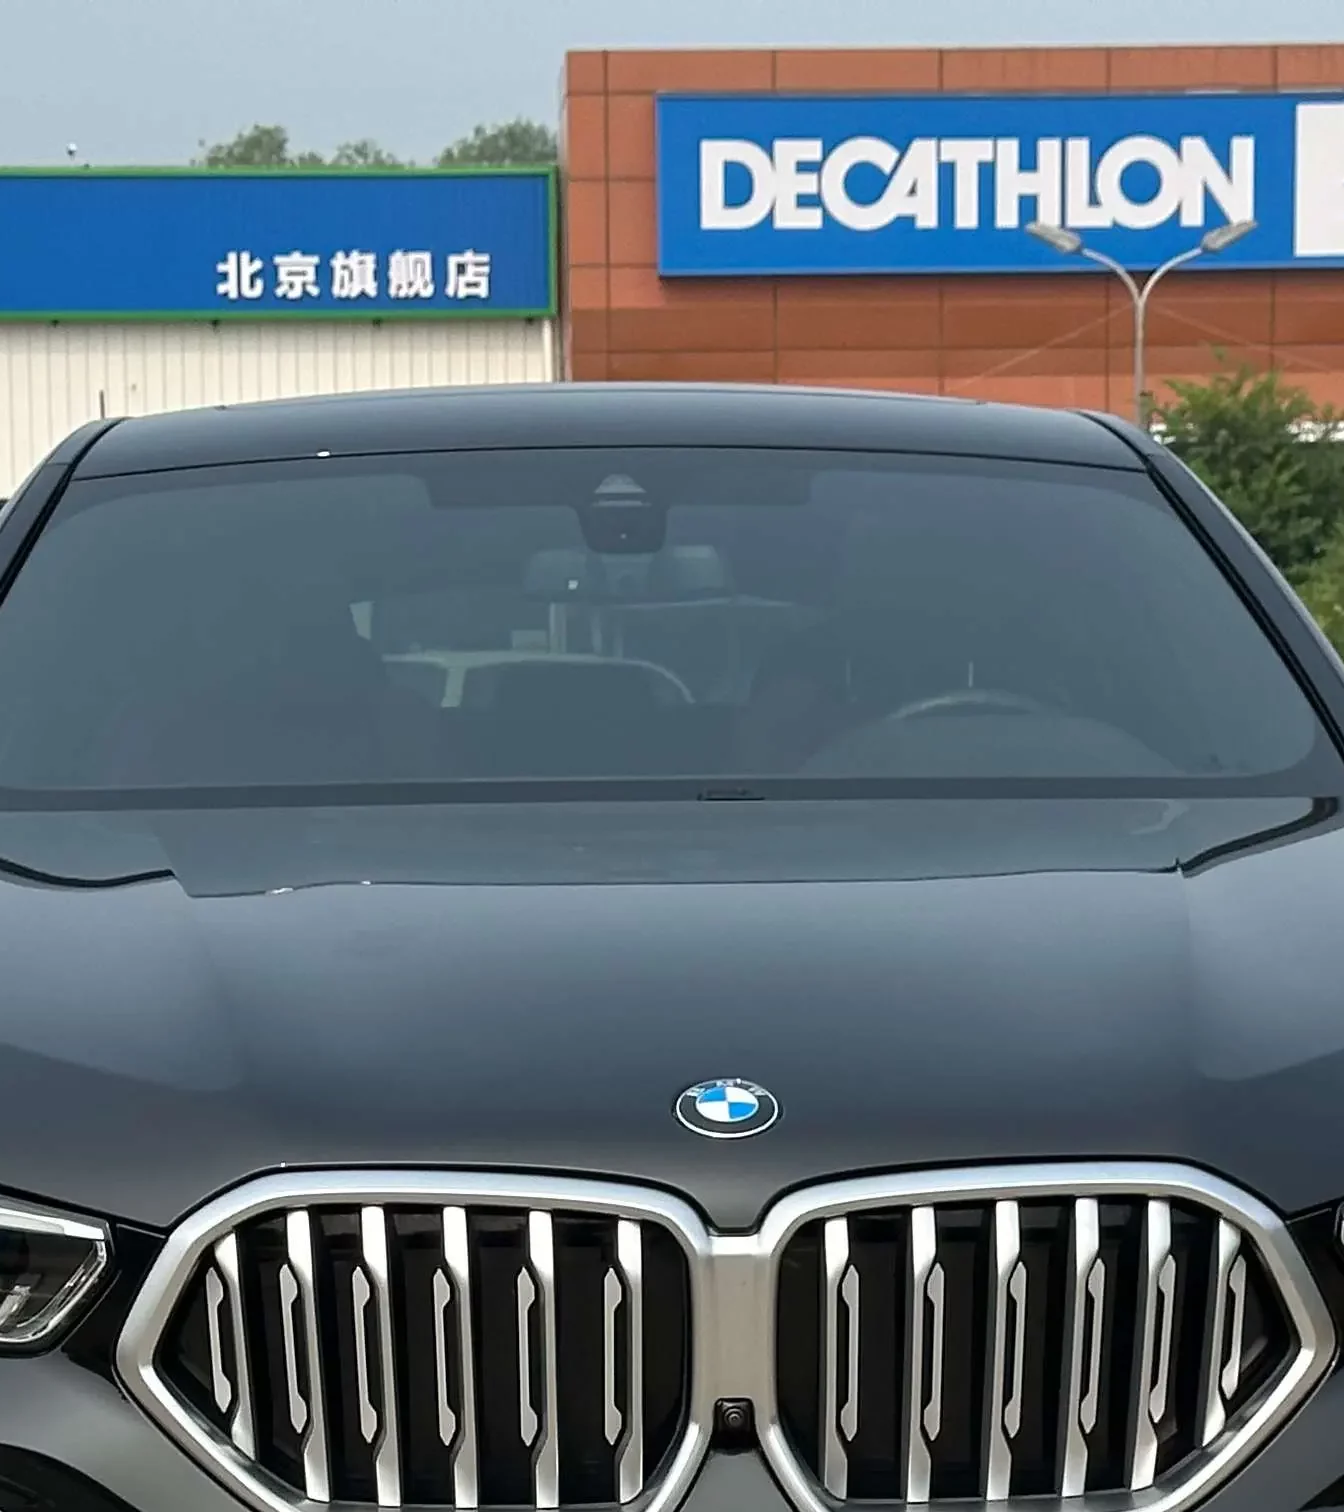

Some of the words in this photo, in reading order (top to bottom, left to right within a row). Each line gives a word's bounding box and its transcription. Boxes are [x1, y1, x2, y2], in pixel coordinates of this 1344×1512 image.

[699, 135, 1256, 231] DECATHLON
[215, 250, 492, 299] 北京旗舰店
